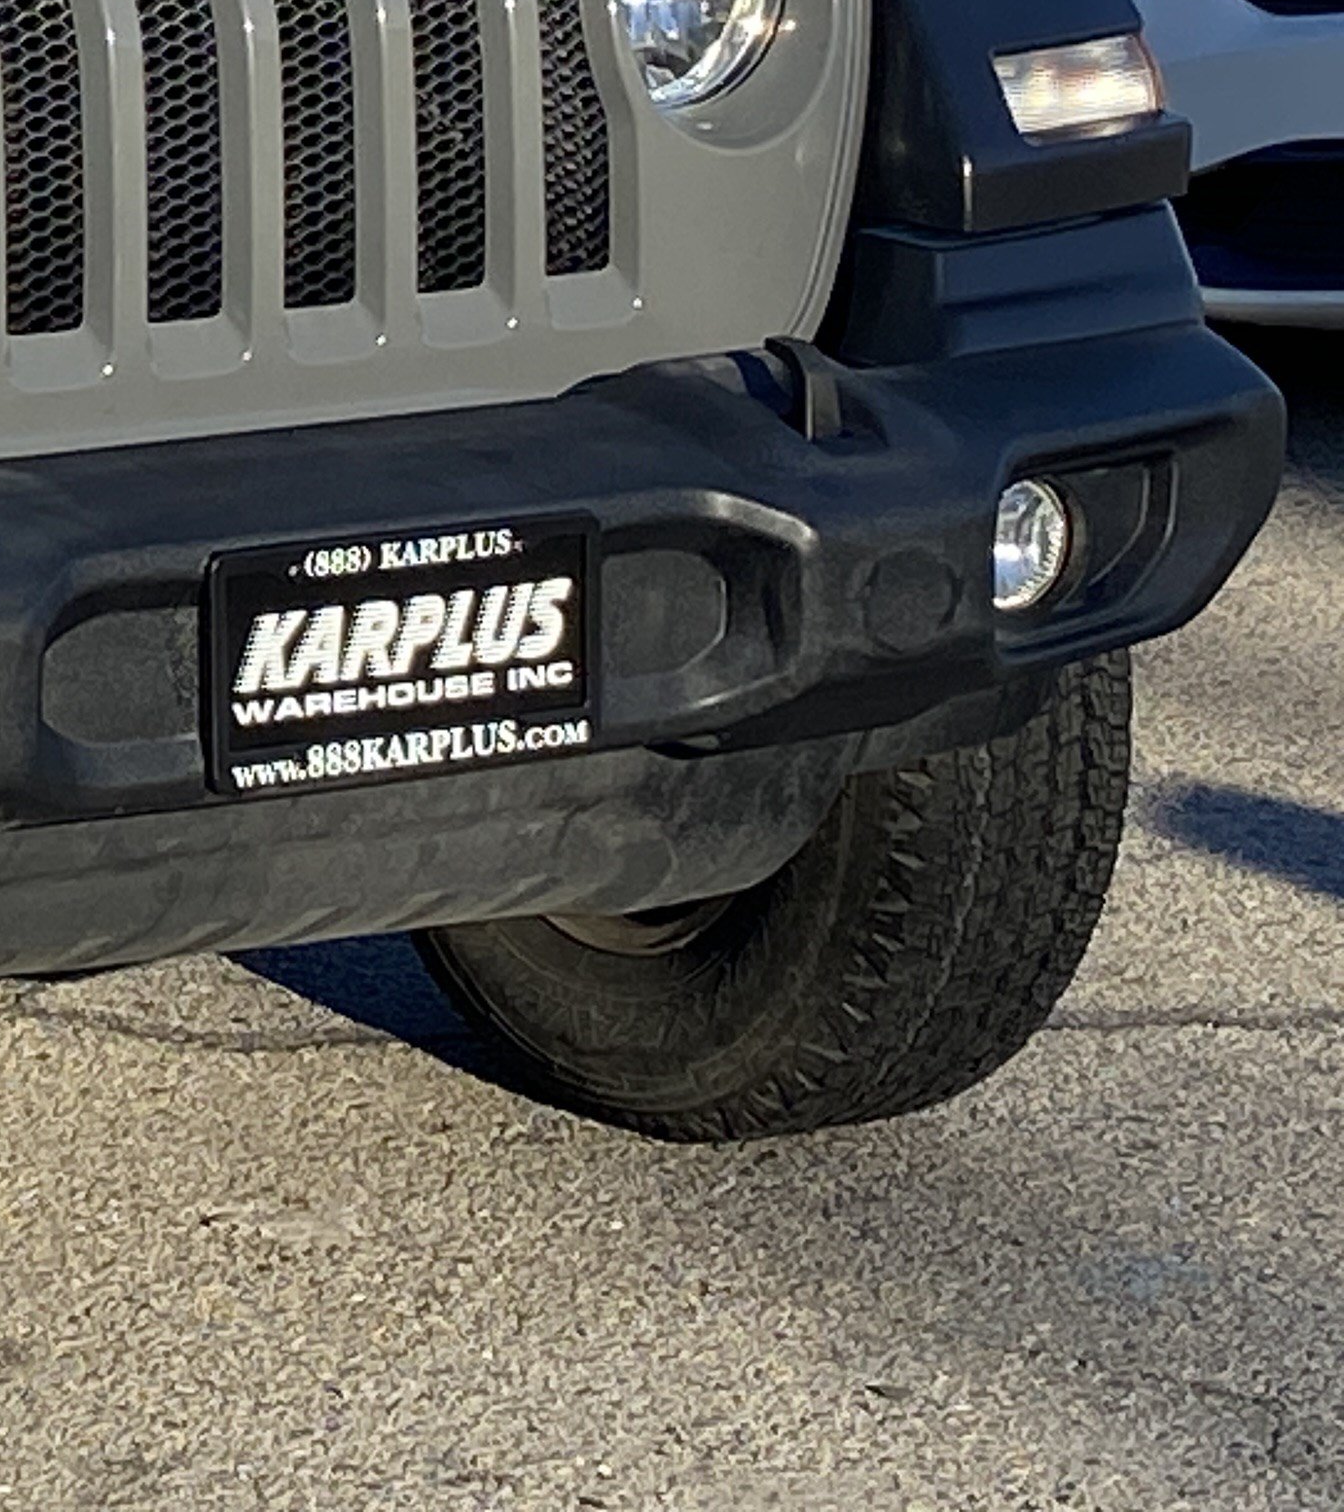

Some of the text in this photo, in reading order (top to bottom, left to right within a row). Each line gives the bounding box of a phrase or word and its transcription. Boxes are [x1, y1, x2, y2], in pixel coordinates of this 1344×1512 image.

[304, 528, 513, 577] (888) KARPLUS
[232, 577, 573, 695] KARPLUS
[231, 661, 574, 727] WAREHOUSE INC
